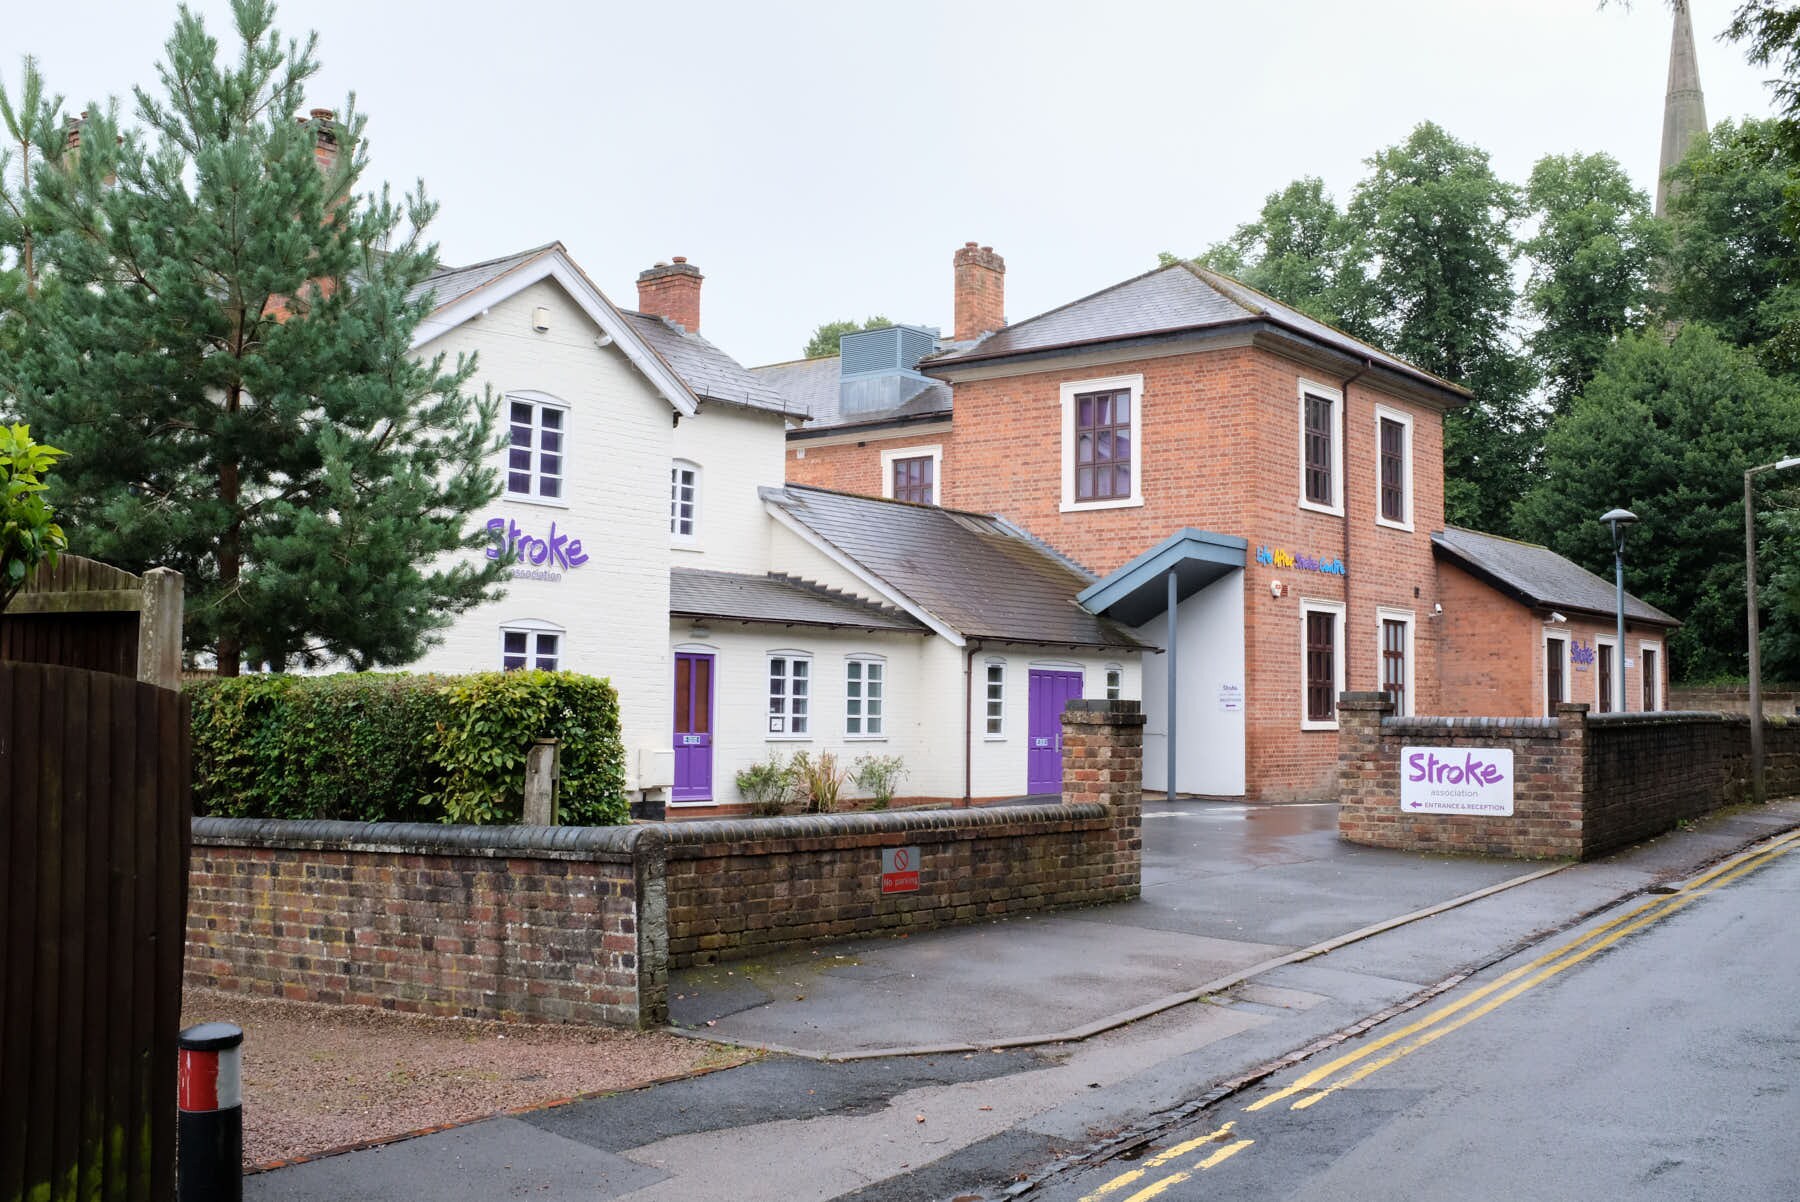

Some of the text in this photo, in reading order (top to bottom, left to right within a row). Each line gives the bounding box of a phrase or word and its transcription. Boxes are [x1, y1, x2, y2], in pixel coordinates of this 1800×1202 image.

[486, 517, 589, 571] Stroke
[1256, 545, 1273, 567] Life
[1274, 548, 1294, 569] After
[1408, 751, 1505, 789] Stroke
[1430, 789, 1479, 798] association
[1424, 801, 1460, 810] ENTRANCE
[1466, 803, 1505, 812] RECEPTION
